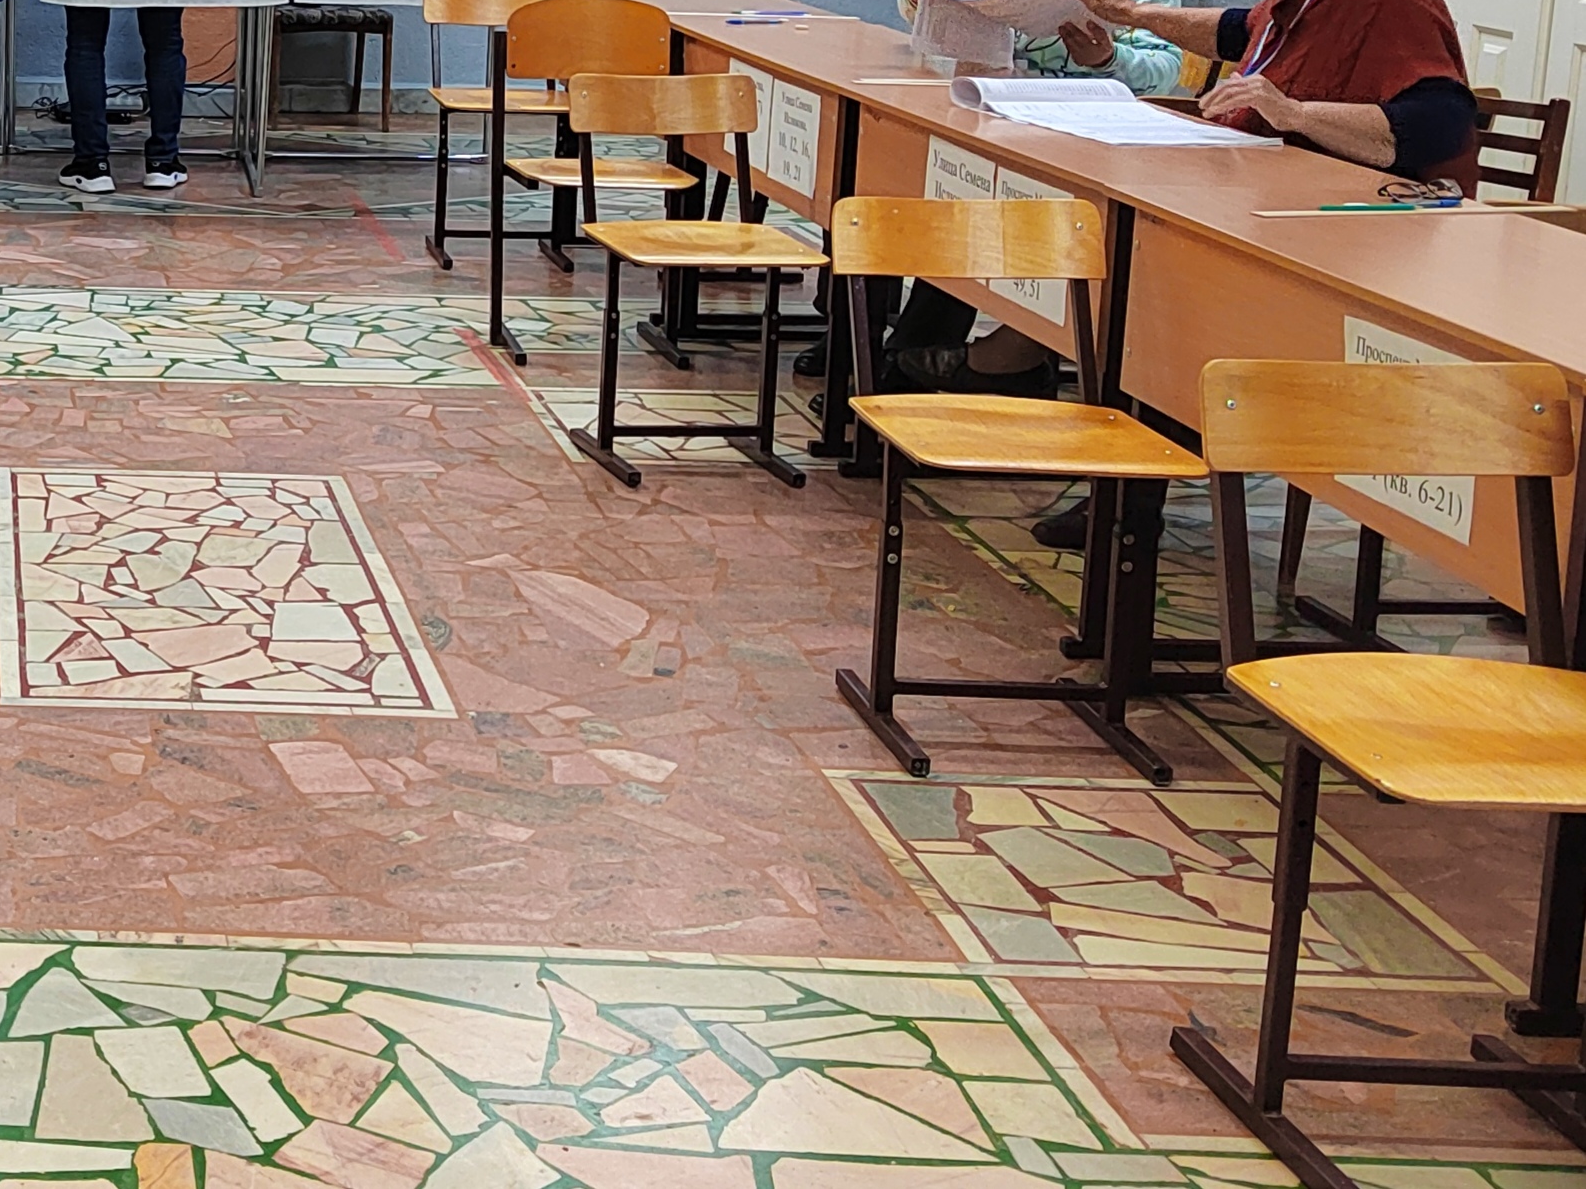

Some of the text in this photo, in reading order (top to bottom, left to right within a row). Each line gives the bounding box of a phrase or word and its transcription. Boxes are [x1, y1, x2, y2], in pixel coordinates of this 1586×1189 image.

[793, 163, 801, 182] 21
[933, 148, 992, 193] Улица Семена
[1028, 279, 1040, 301] 51
[1417, 479, 1463, 527] 6-21)
